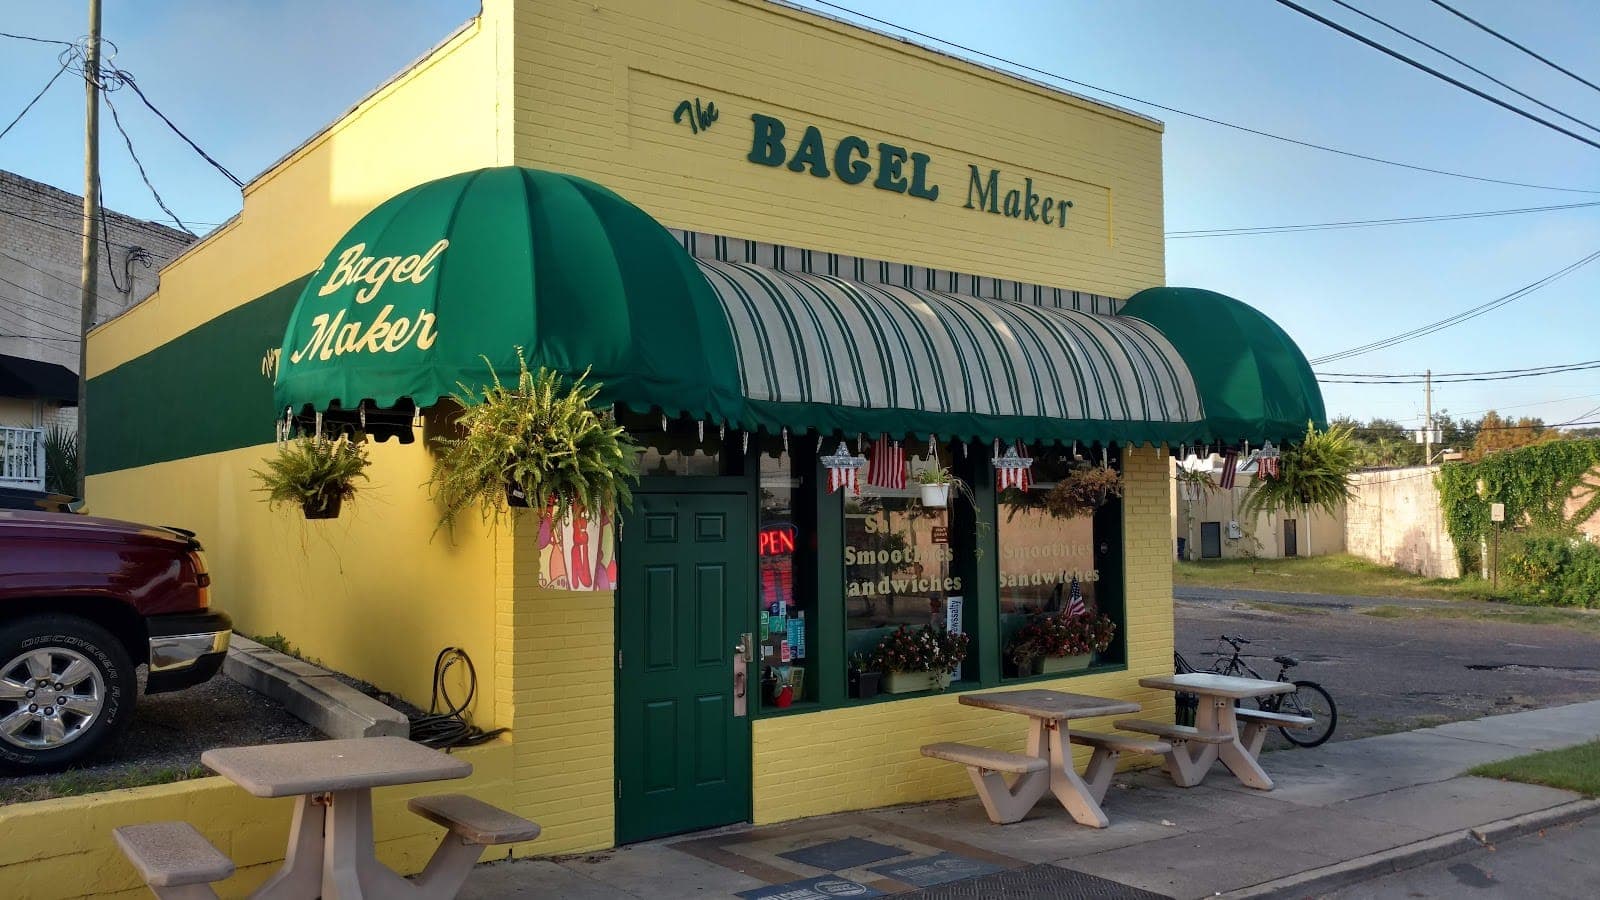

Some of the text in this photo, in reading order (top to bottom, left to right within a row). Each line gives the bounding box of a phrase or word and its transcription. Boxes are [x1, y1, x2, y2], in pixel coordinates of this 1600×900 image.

[673, 97, 1074, 228] The BAGEL Maker
[318, 239, 449, 304] Bagel
[290, 304, 438, 364] Maker
[759, 529, 795, 556] PEN
[845, 574, 962, 598] andwiches
[999, 566, 1101, 589] Sandwiches
[21, 634, 119, 680] DISCOVERER
